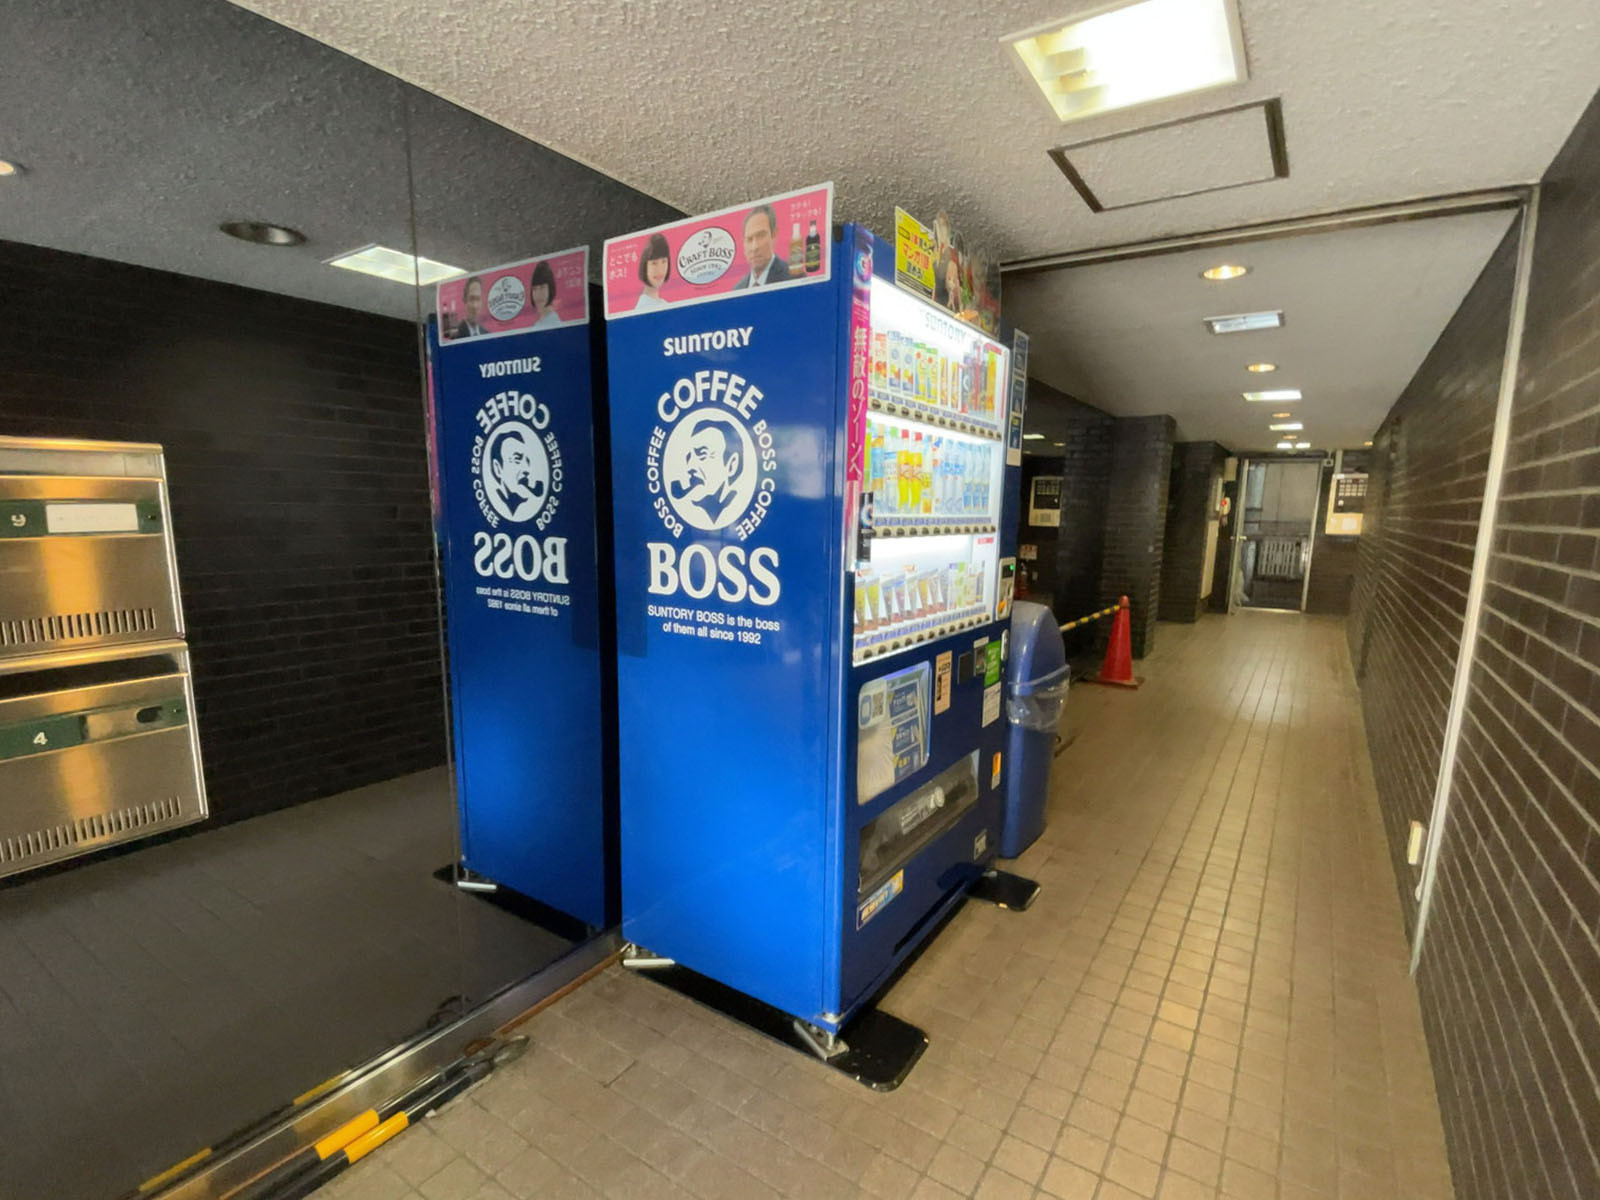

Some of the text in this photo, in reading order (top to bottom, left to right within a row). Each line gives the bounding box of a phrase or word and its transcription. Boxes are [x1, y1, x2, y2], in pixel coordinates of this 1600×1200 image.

[679, 247, 734, 268] CRAFT BOSS
[663, 327, 753, 356] SUNTORY
[658, 370, 764, 422] COFFEE
[647, 426, 684, 538] BOSS COFFEE
[735, 419, 777, 541] BOSS COFFEE
[647, 543, 780, 605] BOSS
[648, 604, 780, 631] SUNTORY BOSS is the boss
[663, 622, 761, 644] of them all since 1992
[33, 732, 48, 745] 4
